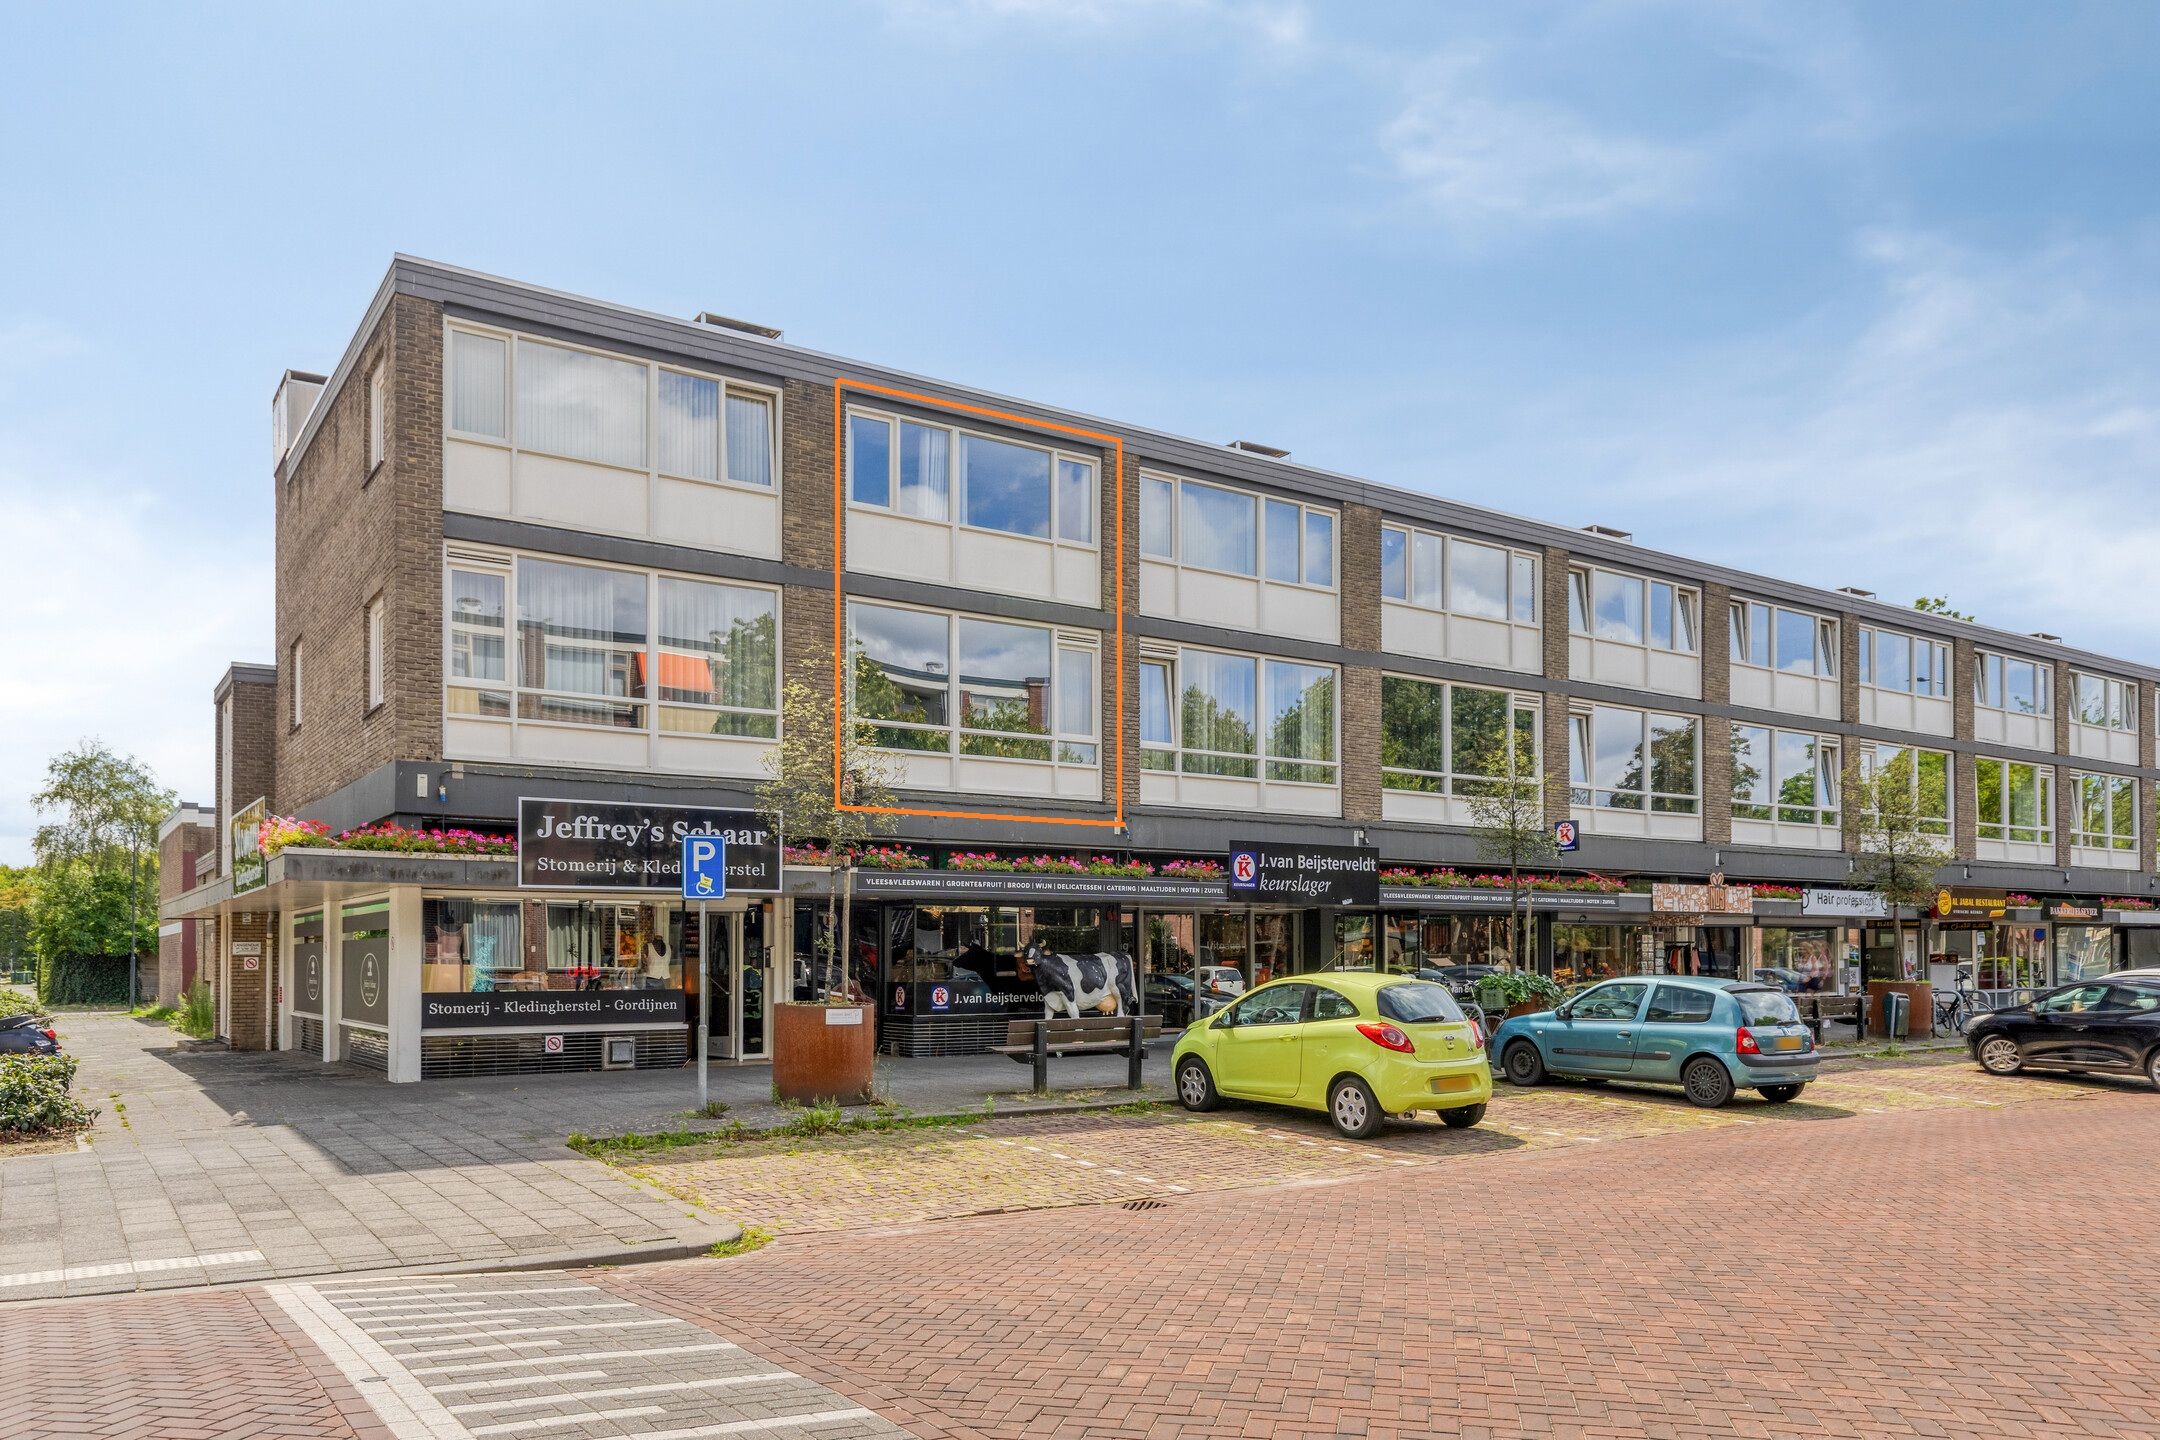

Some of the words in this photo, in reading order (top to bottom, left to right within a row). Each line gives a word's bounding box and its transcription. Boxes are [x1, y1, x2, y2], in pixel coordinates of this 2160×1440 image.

[537, 815, 665, 847] Jeffrey’s
[693, 841, 716, 872] P
[1259, 853, 1294, 869] J.van
[1297, 854, 1377, 874] Beijsterveldt
[537, 857, 616, 876] Stomerij
[623, 859, 637, 874] &
[1237, 861, 1252, 878] K
[866, 878, 941, 887] VLEES&VLEESWAREN
[946, 880, 1003, 889] GROENTE&FRUIT
[1007, 881, 1031, 889] BROOD
[1035, 882, 1053, 890] WIJN
[1056, 883, 1102, 891] DELICATESSEN
[1259, 872, 1332, 897] keurslager
[1817, 892, 1835, 905] Hair
[750, 911, 756, 924] 1
[567, 965, 599, 977] OPEN
[954, 992, 982, 1004] J.van
[429, 1002, 491, 1017] Stomerij
[503, 1000, 601, 1015] Kledingherstel
[614, 998, 678, 1013] Gordijnen
